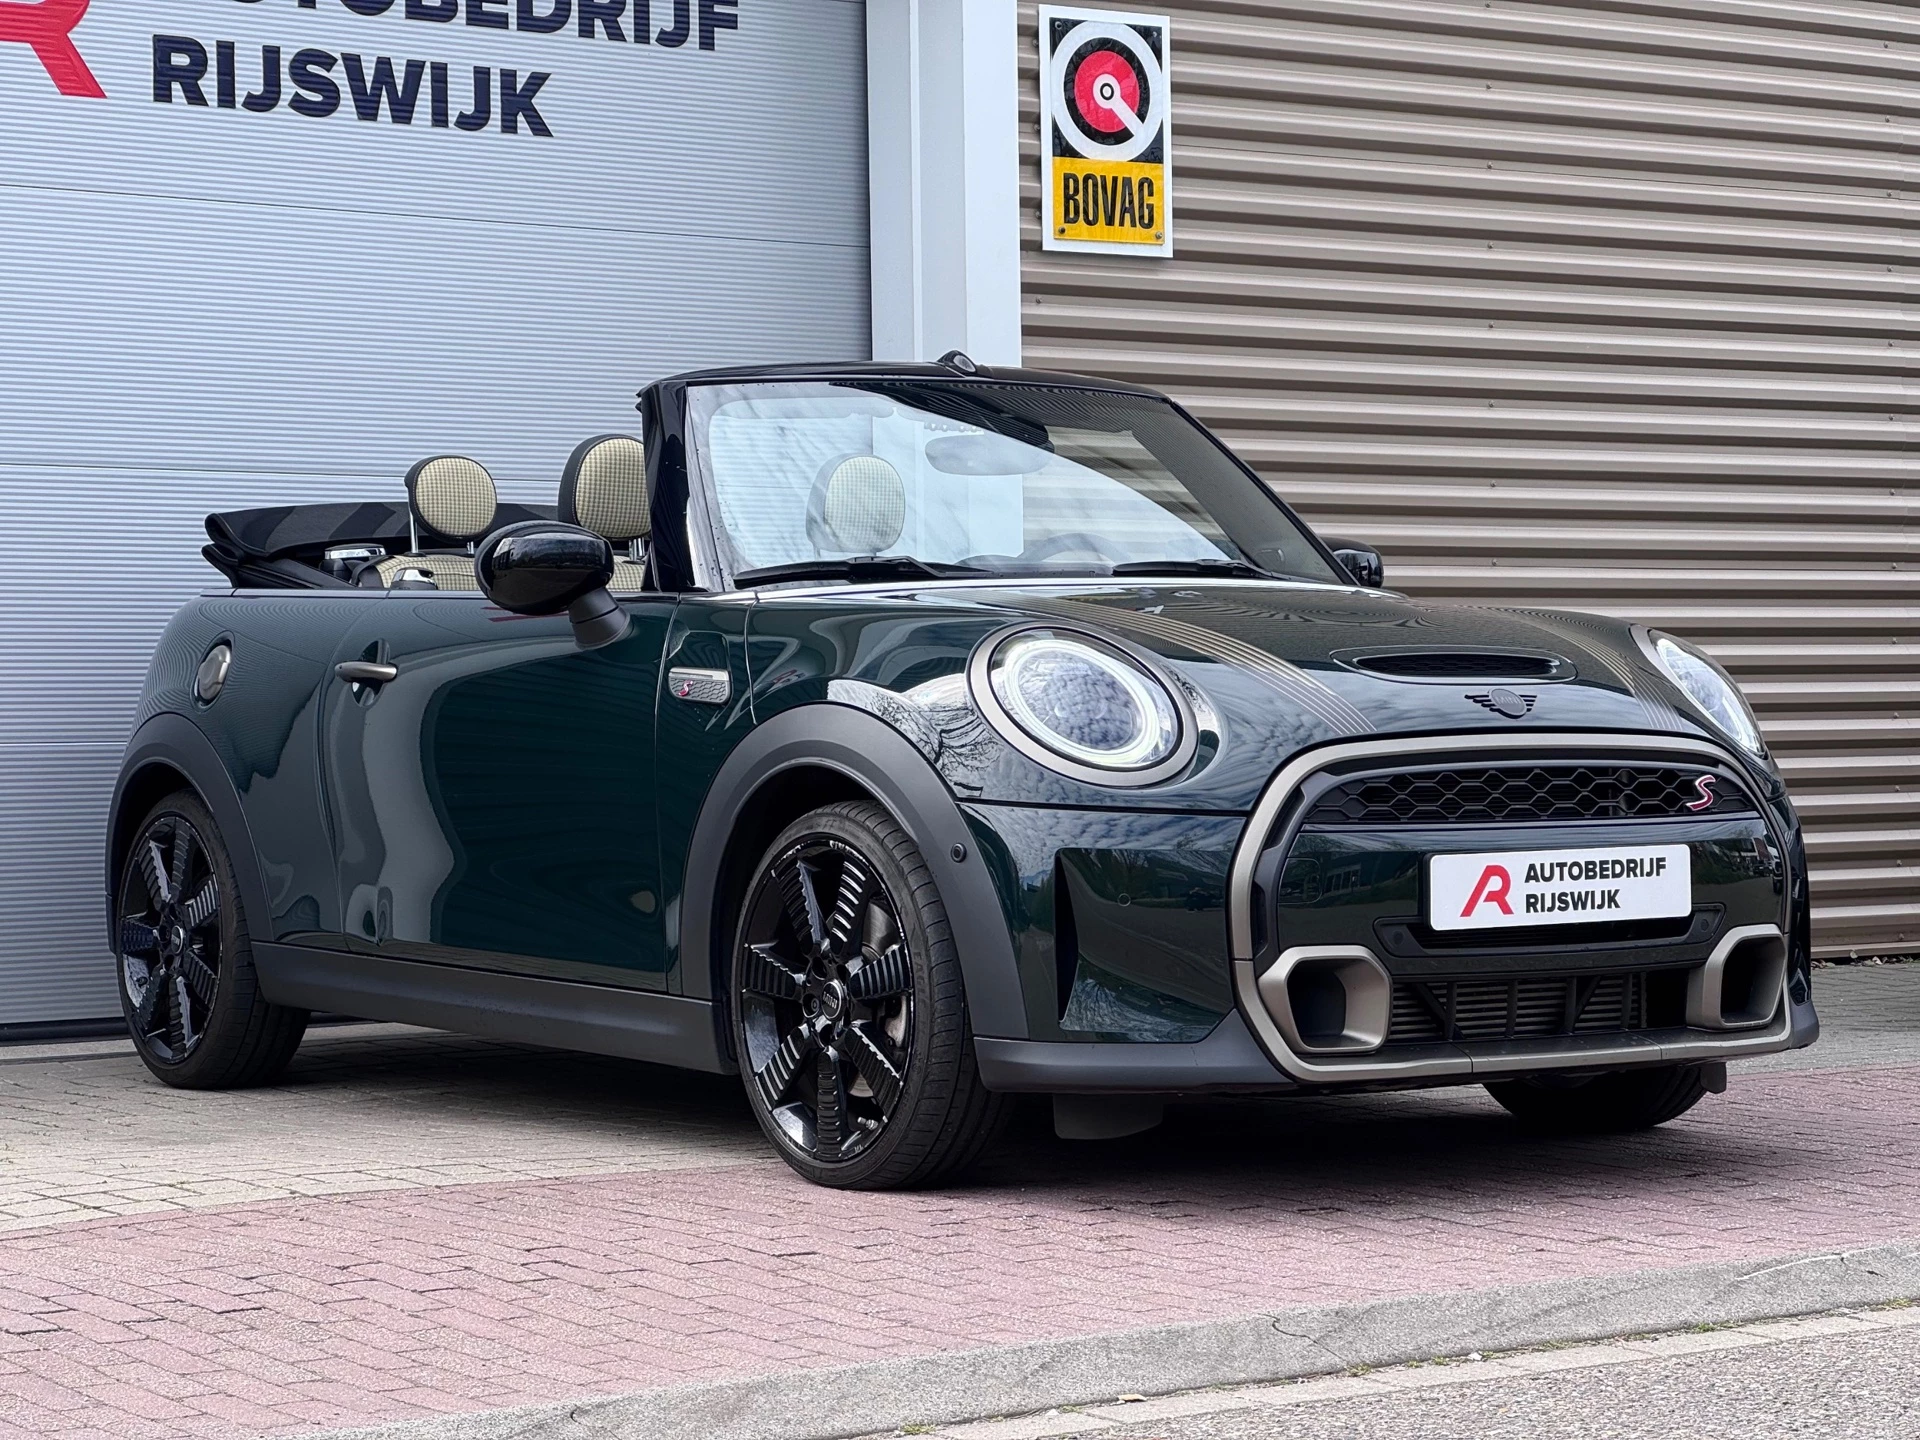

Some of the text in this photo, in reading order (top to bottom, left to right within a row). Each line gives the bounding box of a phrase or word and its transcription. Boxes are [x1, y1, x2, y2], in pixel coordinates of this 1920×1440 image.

[152, 33, 554, 138] RIJSWIJK
[1062, 172, 1155, 230] BOVAG
[1686, 774, 1716, 811] S
[1524, 856, 1667, 883] AUTOBEDRIJF
[1525, 889, 1621, 914] RIJSWIJK
